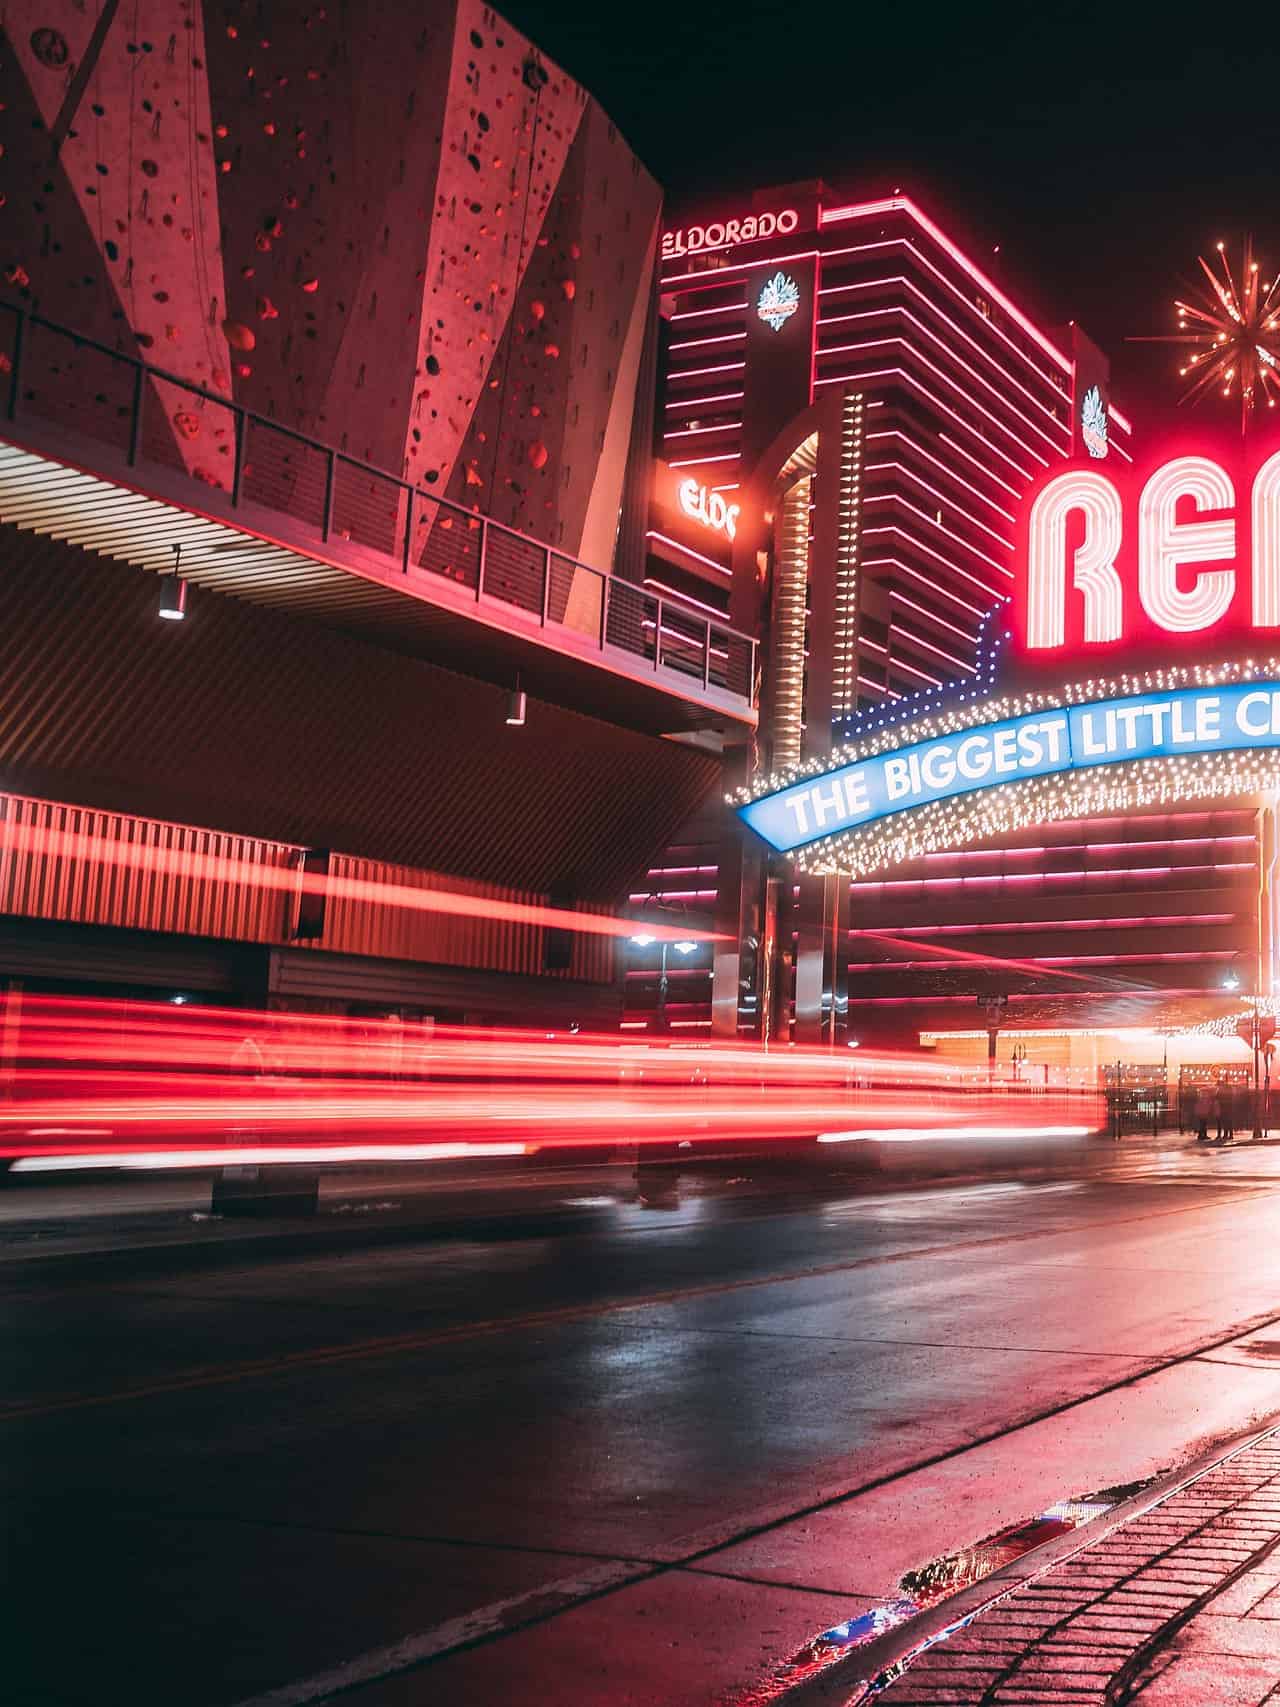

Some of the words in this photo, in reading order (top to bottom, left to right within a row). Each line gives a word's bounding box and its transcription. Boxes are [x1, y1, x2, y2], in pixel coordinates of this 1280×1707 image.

[661, 209, 799, 256] ELDORADO
[786, 770, 871, 833] THE
[884, 719, 1066, 801] BIGGEST
[1082, 697, 1220, 756] LITTLE
